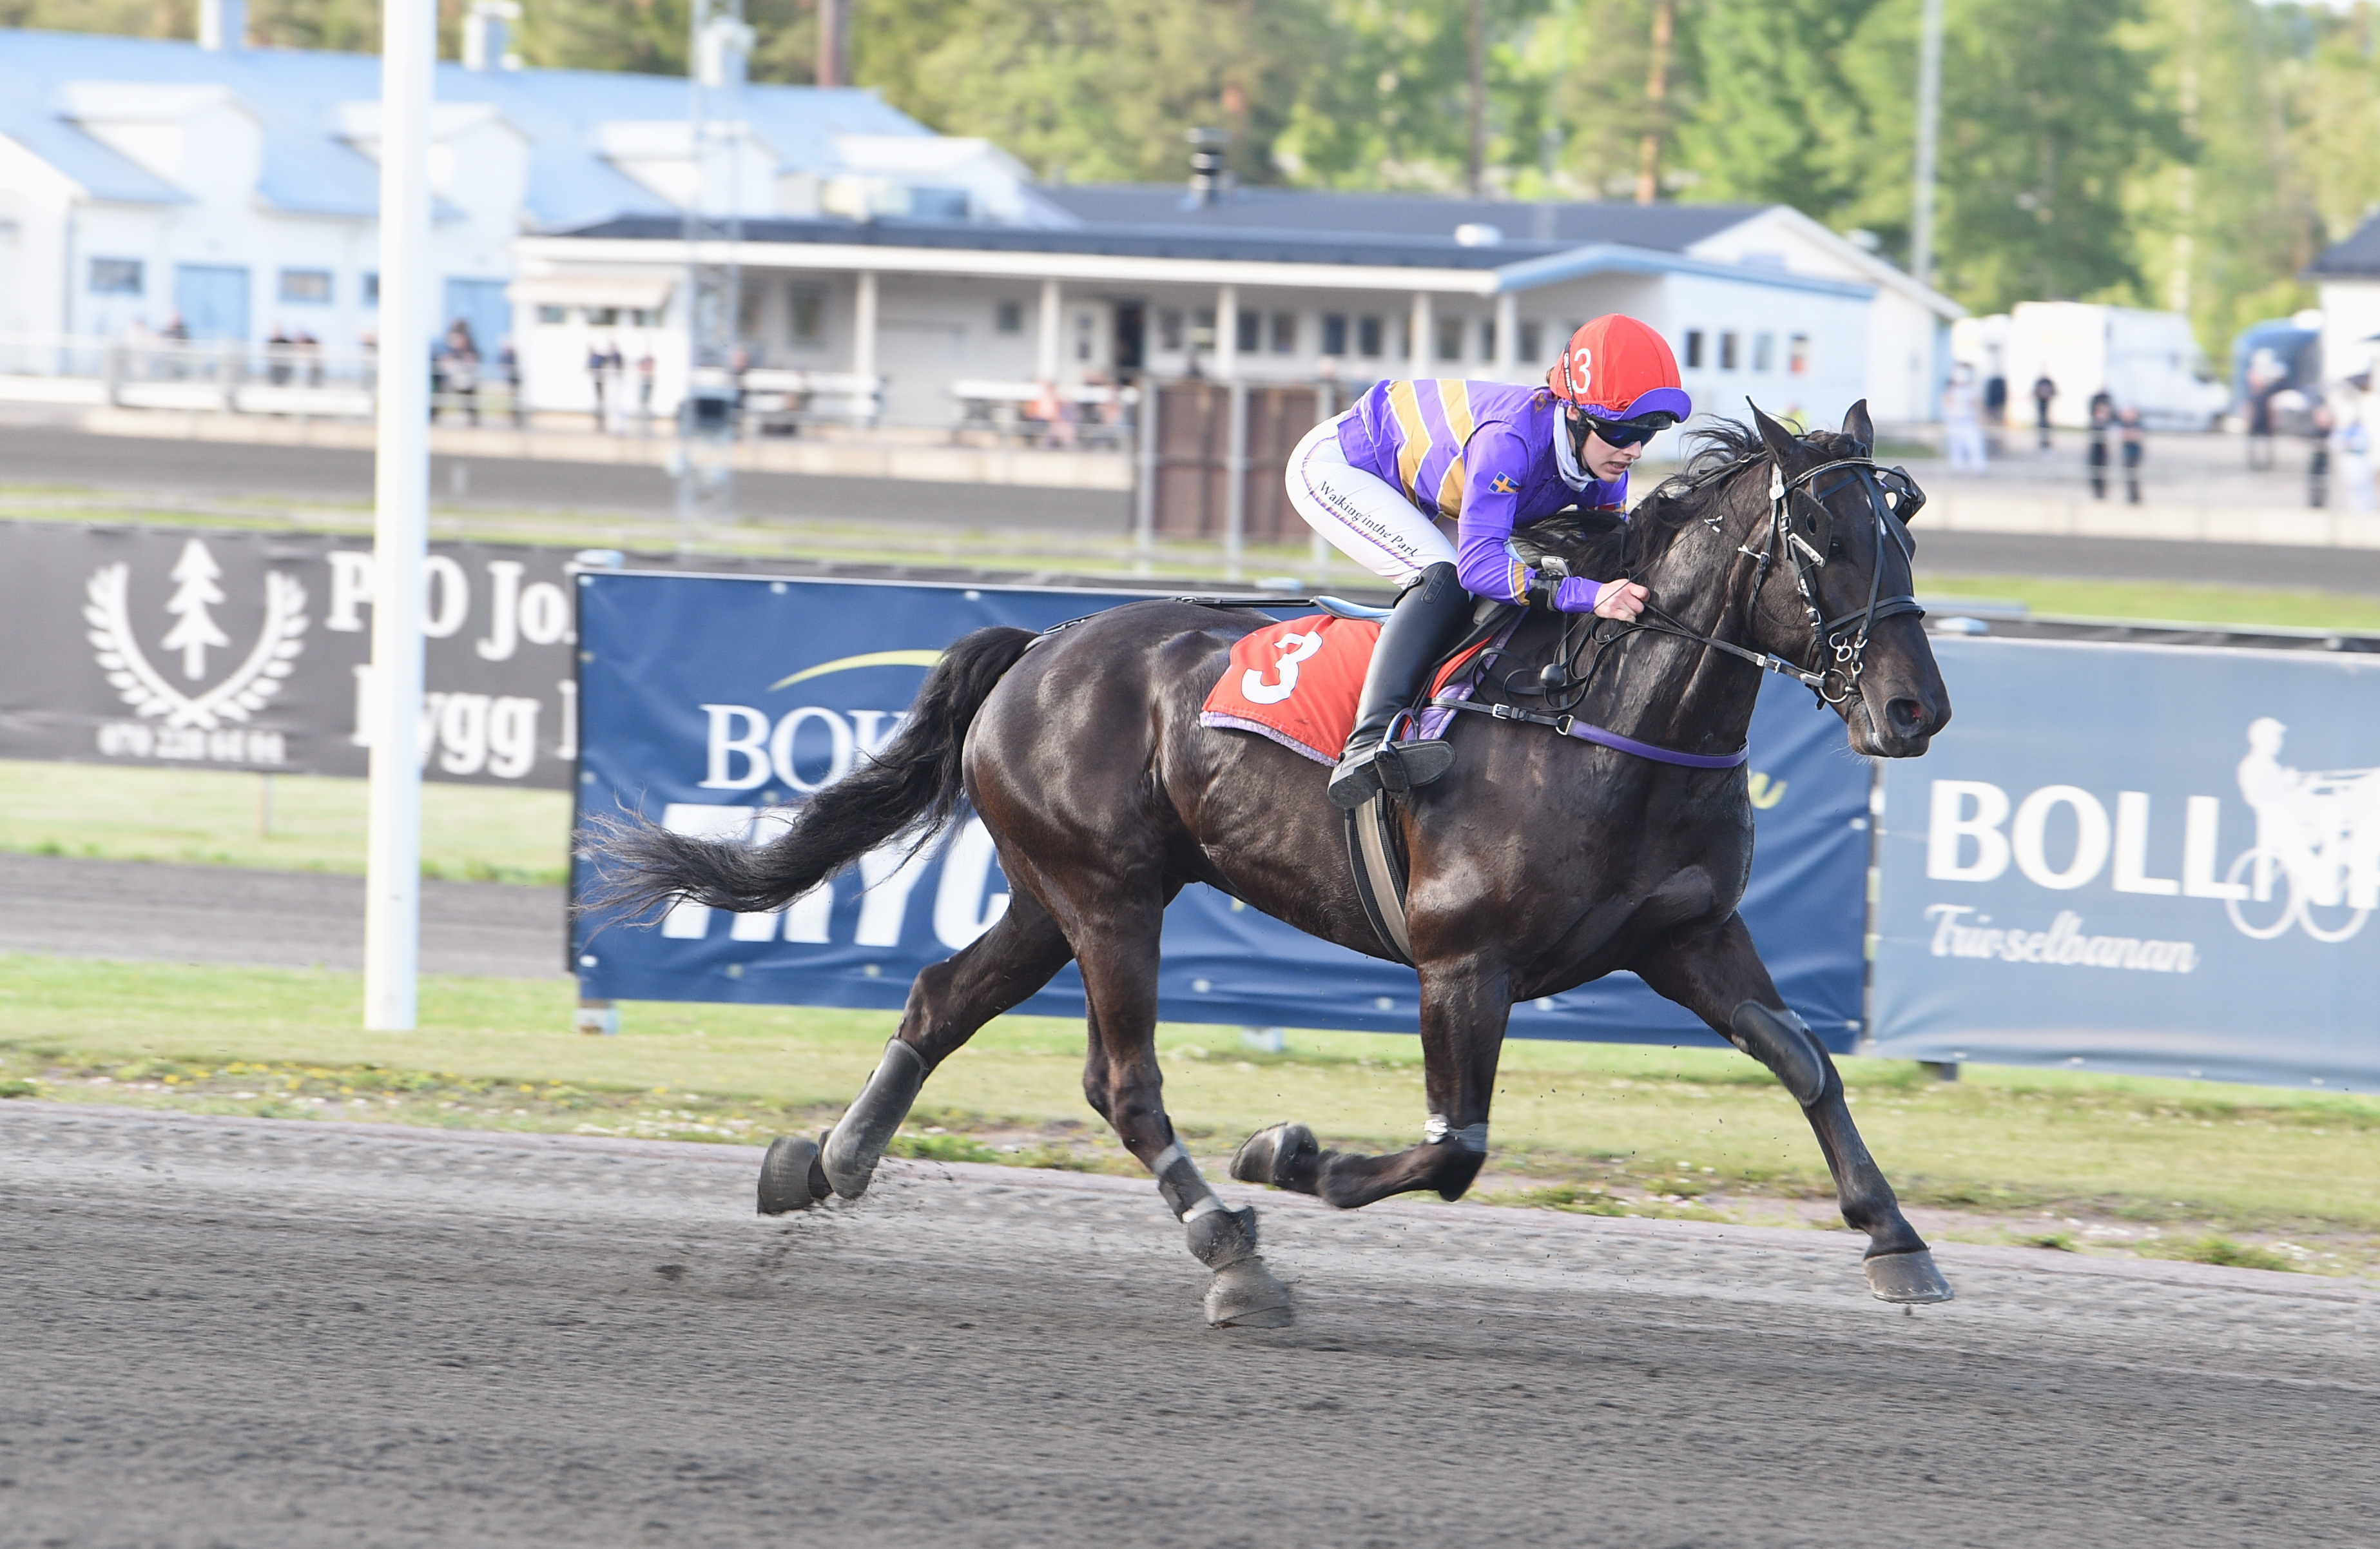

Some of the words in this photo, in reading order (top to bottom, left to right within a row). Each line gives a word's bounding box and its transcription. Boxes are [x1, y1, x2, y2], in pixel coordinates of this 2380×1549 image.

[1572, 348, 1591, 394] 3
[1321, 480, 1363, 521] Walking
[1390, 535, 1418, 557] Park
[1241, 631, 1323, 705] 3
